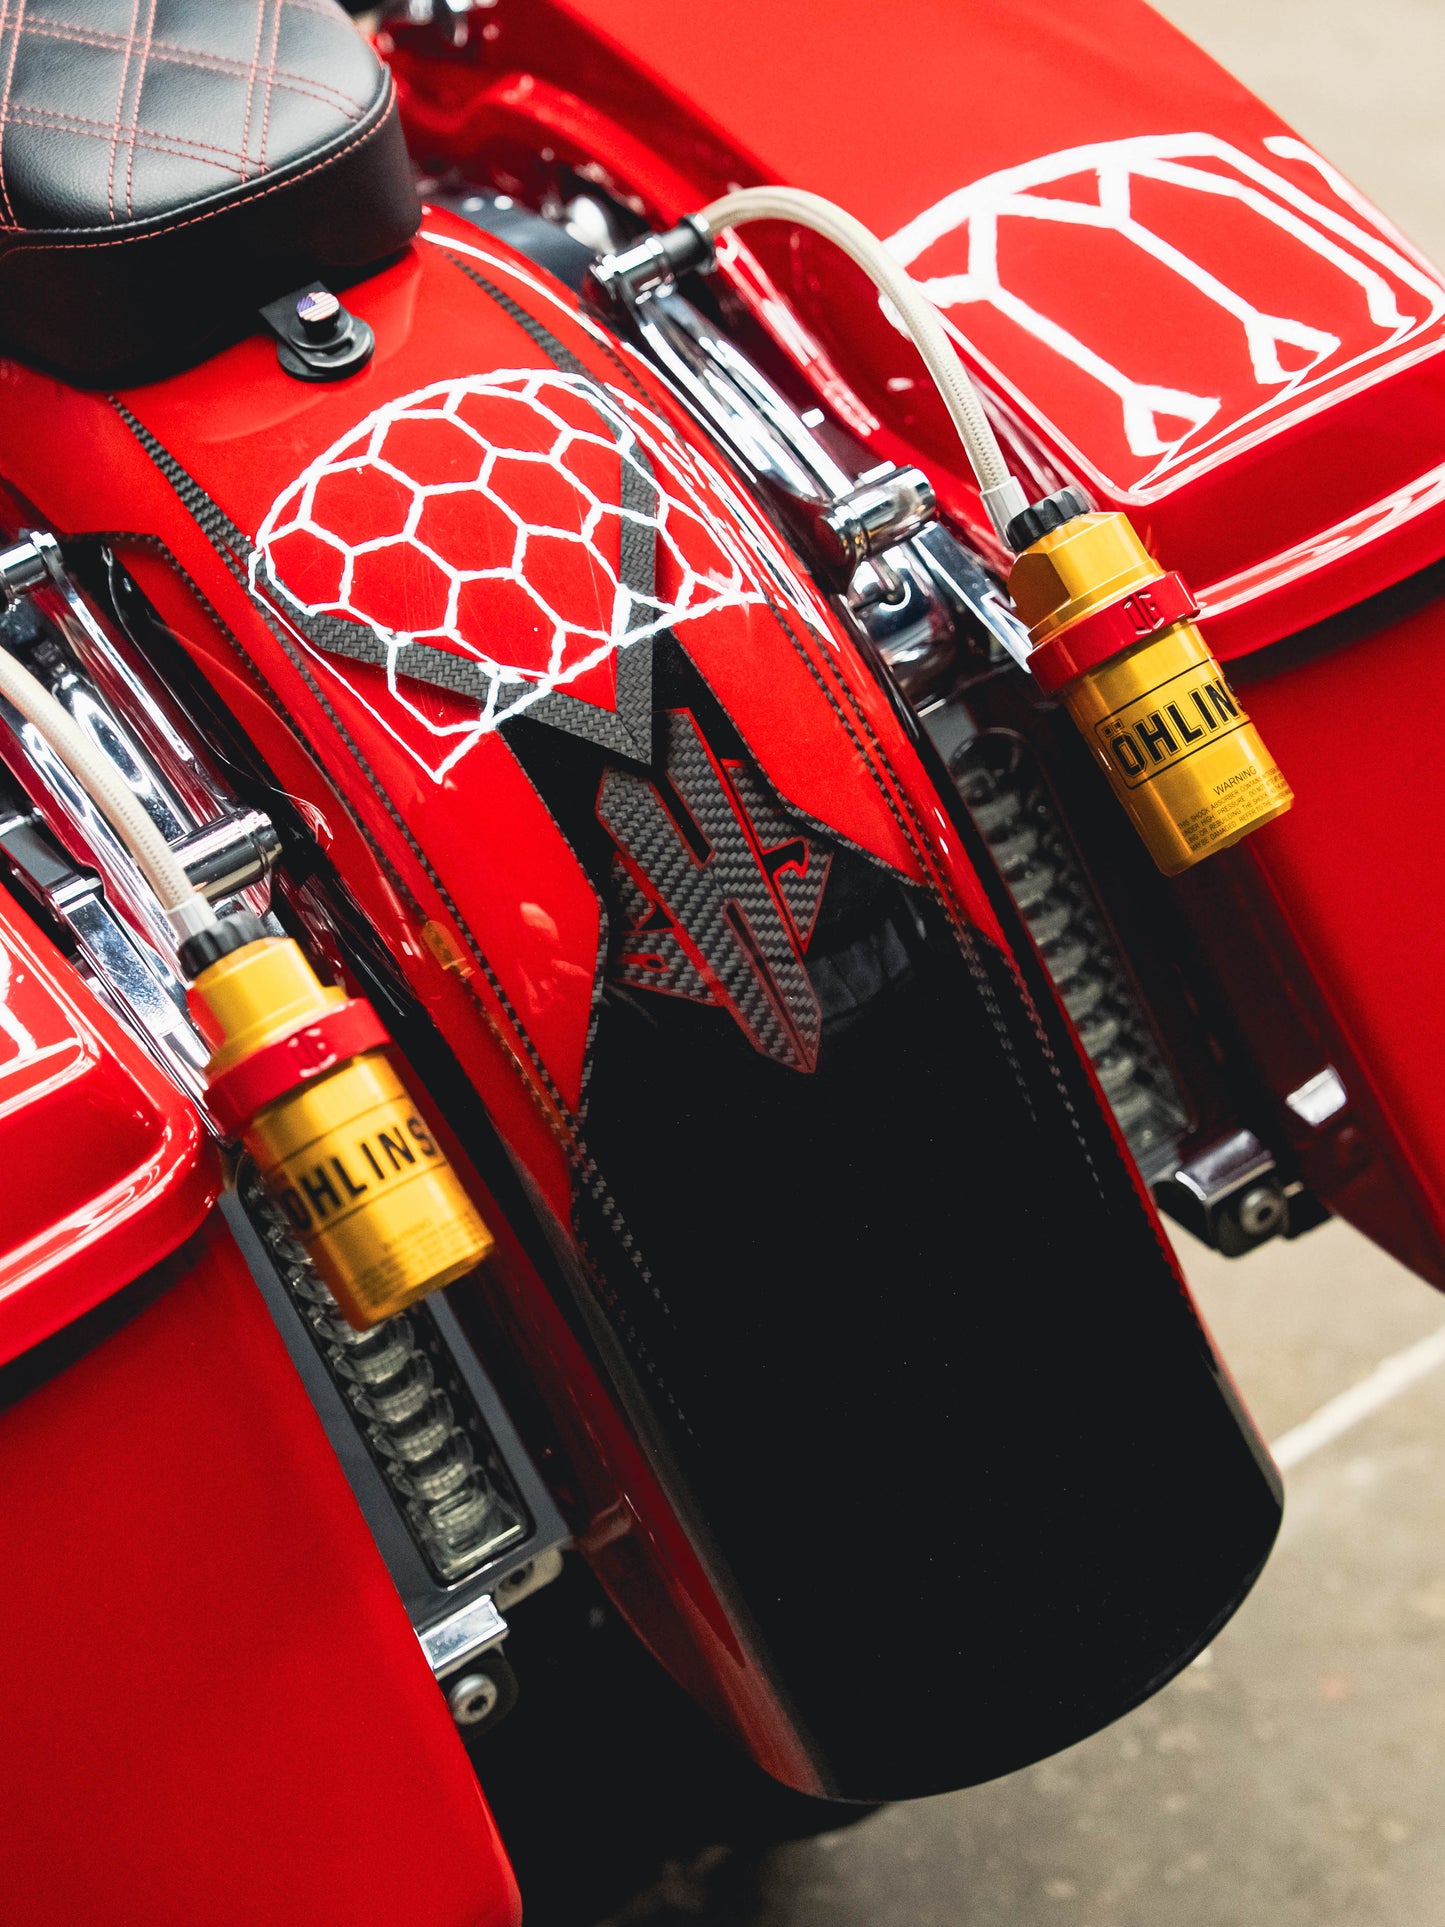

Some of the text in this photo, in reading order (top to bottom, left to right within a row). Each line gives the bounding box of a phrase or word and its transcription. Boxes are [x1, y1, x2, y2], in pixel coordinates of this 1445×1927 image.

[1103, 677, 1243, 777] ÖHLIN
[1213, 764, 1257, 796] WARNING
[1209, 789, 1240, 810] ABSORBER
